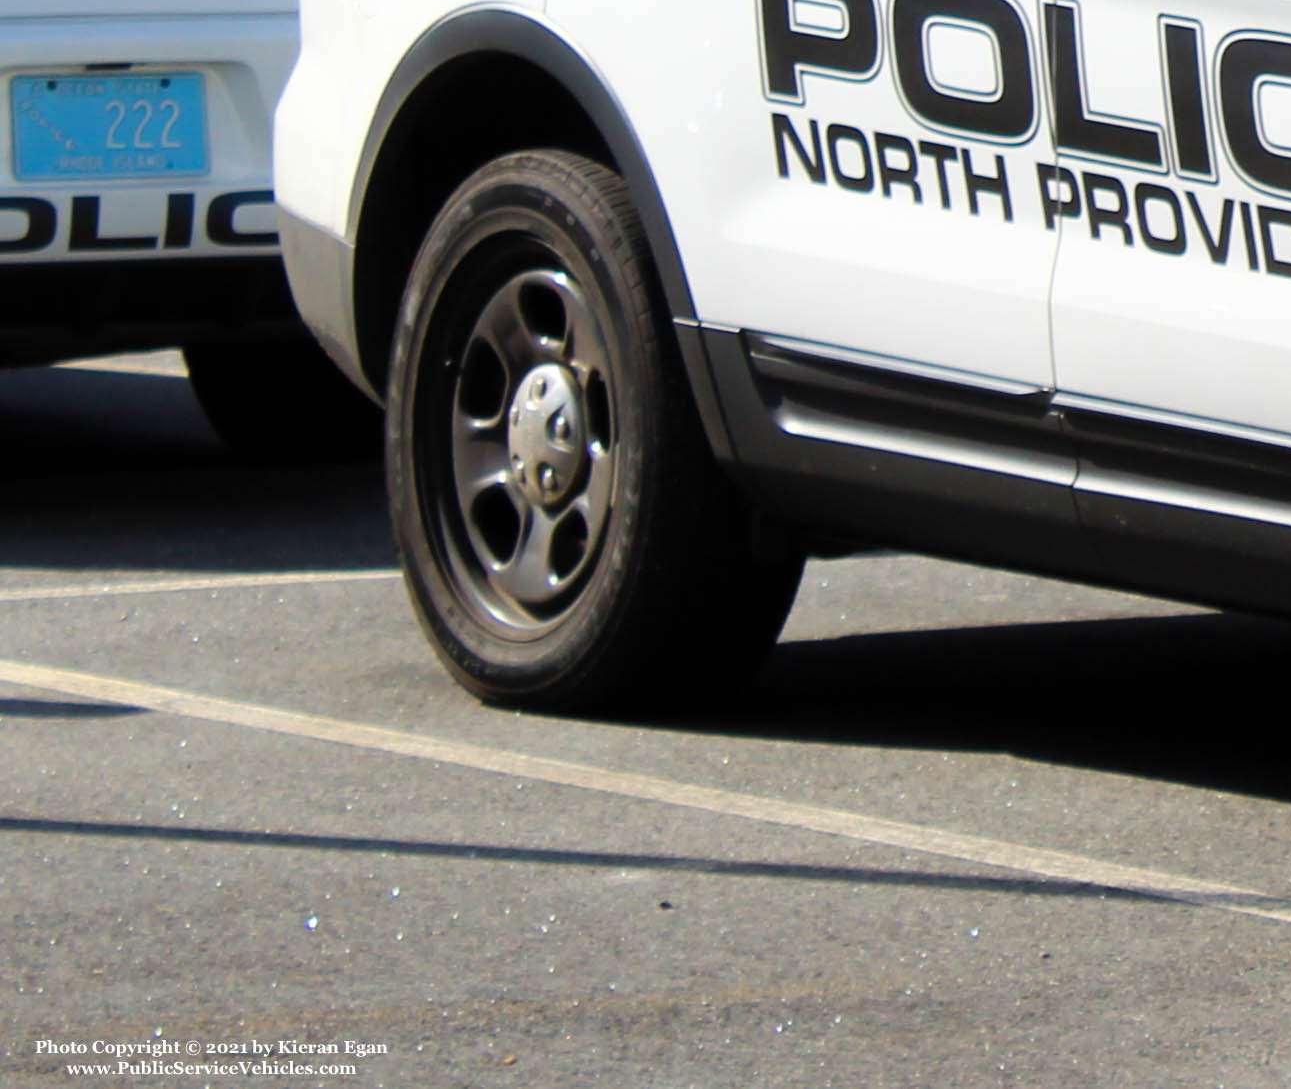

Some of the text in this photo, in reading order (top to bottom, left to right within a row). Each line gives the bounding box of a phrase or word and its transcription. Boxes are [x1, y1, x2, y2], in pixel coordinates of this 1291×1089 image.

[105, 99, 182, 150] 222
[771, 113, 1014, 221] NORTH
[0, 190, 280, 253] OLIC
